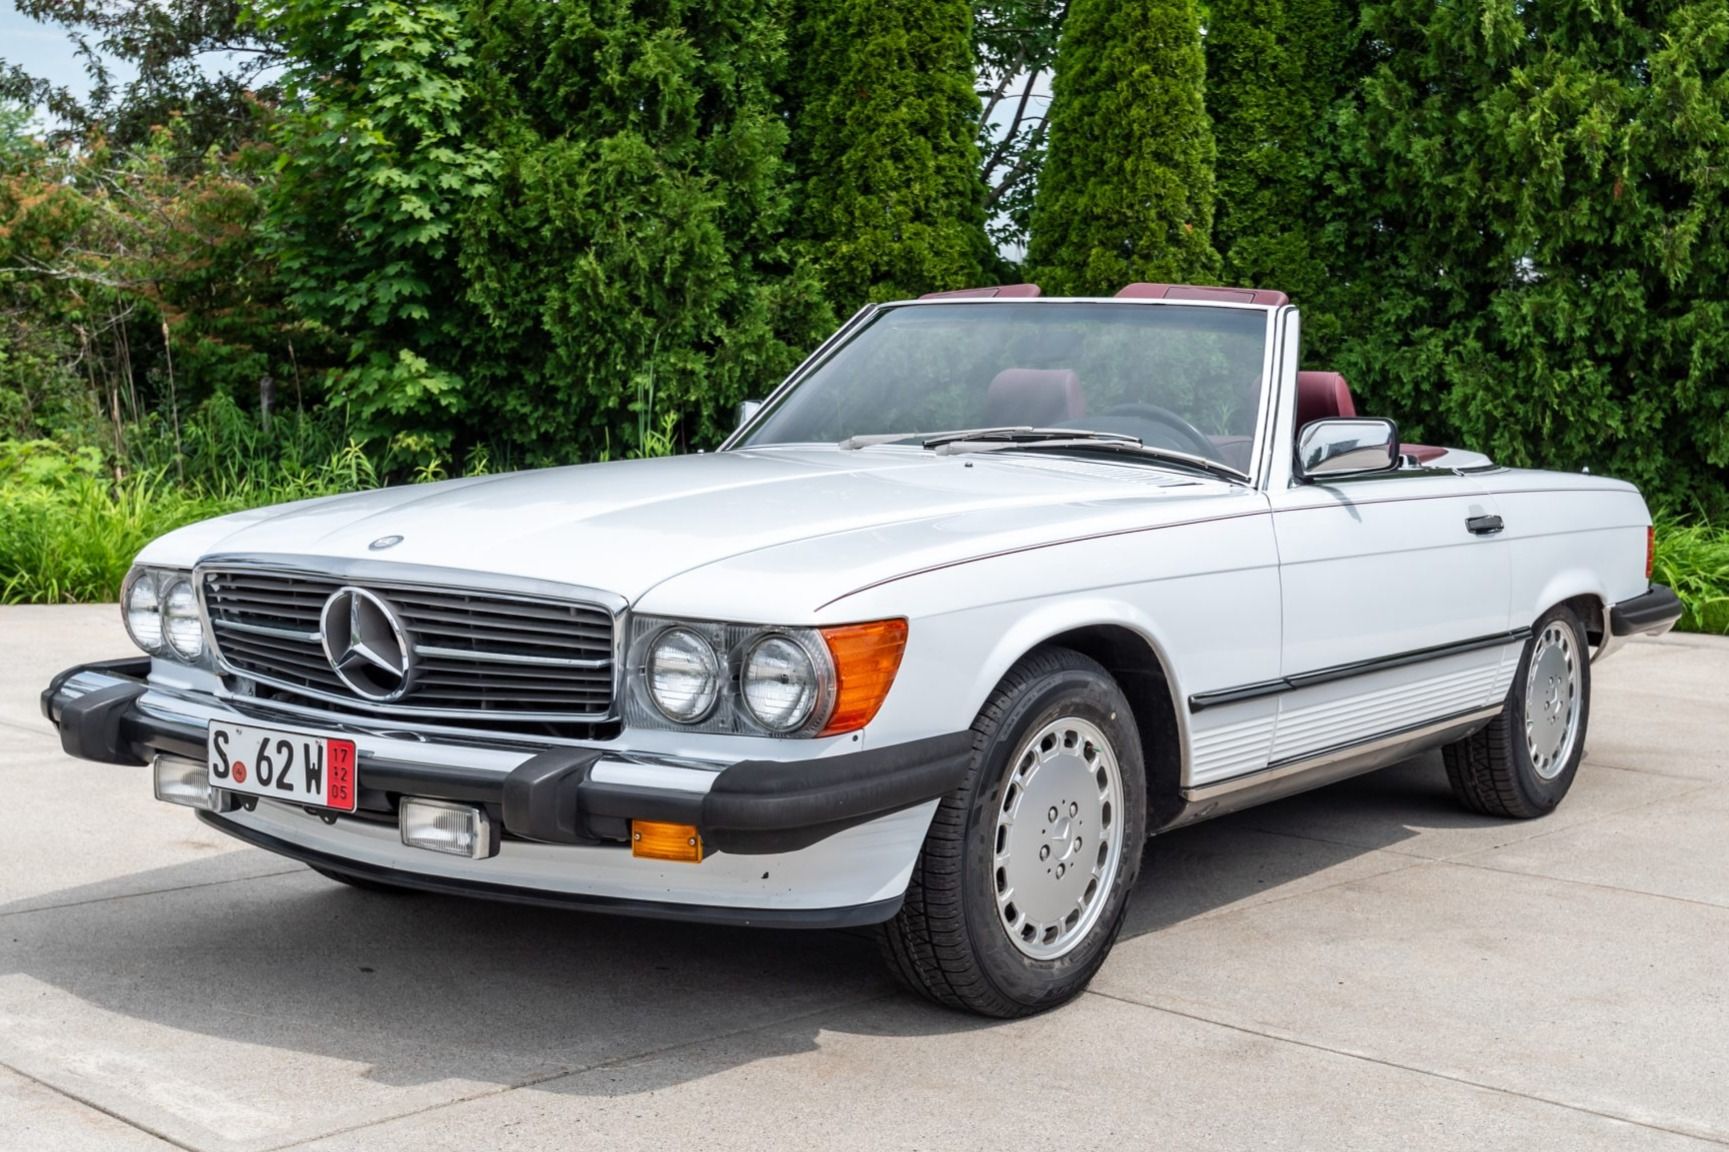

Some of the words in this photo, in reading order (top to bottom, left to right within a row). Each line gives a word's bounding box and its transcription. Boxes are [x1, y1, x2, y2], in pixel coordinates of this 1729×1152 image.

[213, 730, 230, 778] S
[332, 748, 348, 763] 17
[331, 784, 348, 799] 05
